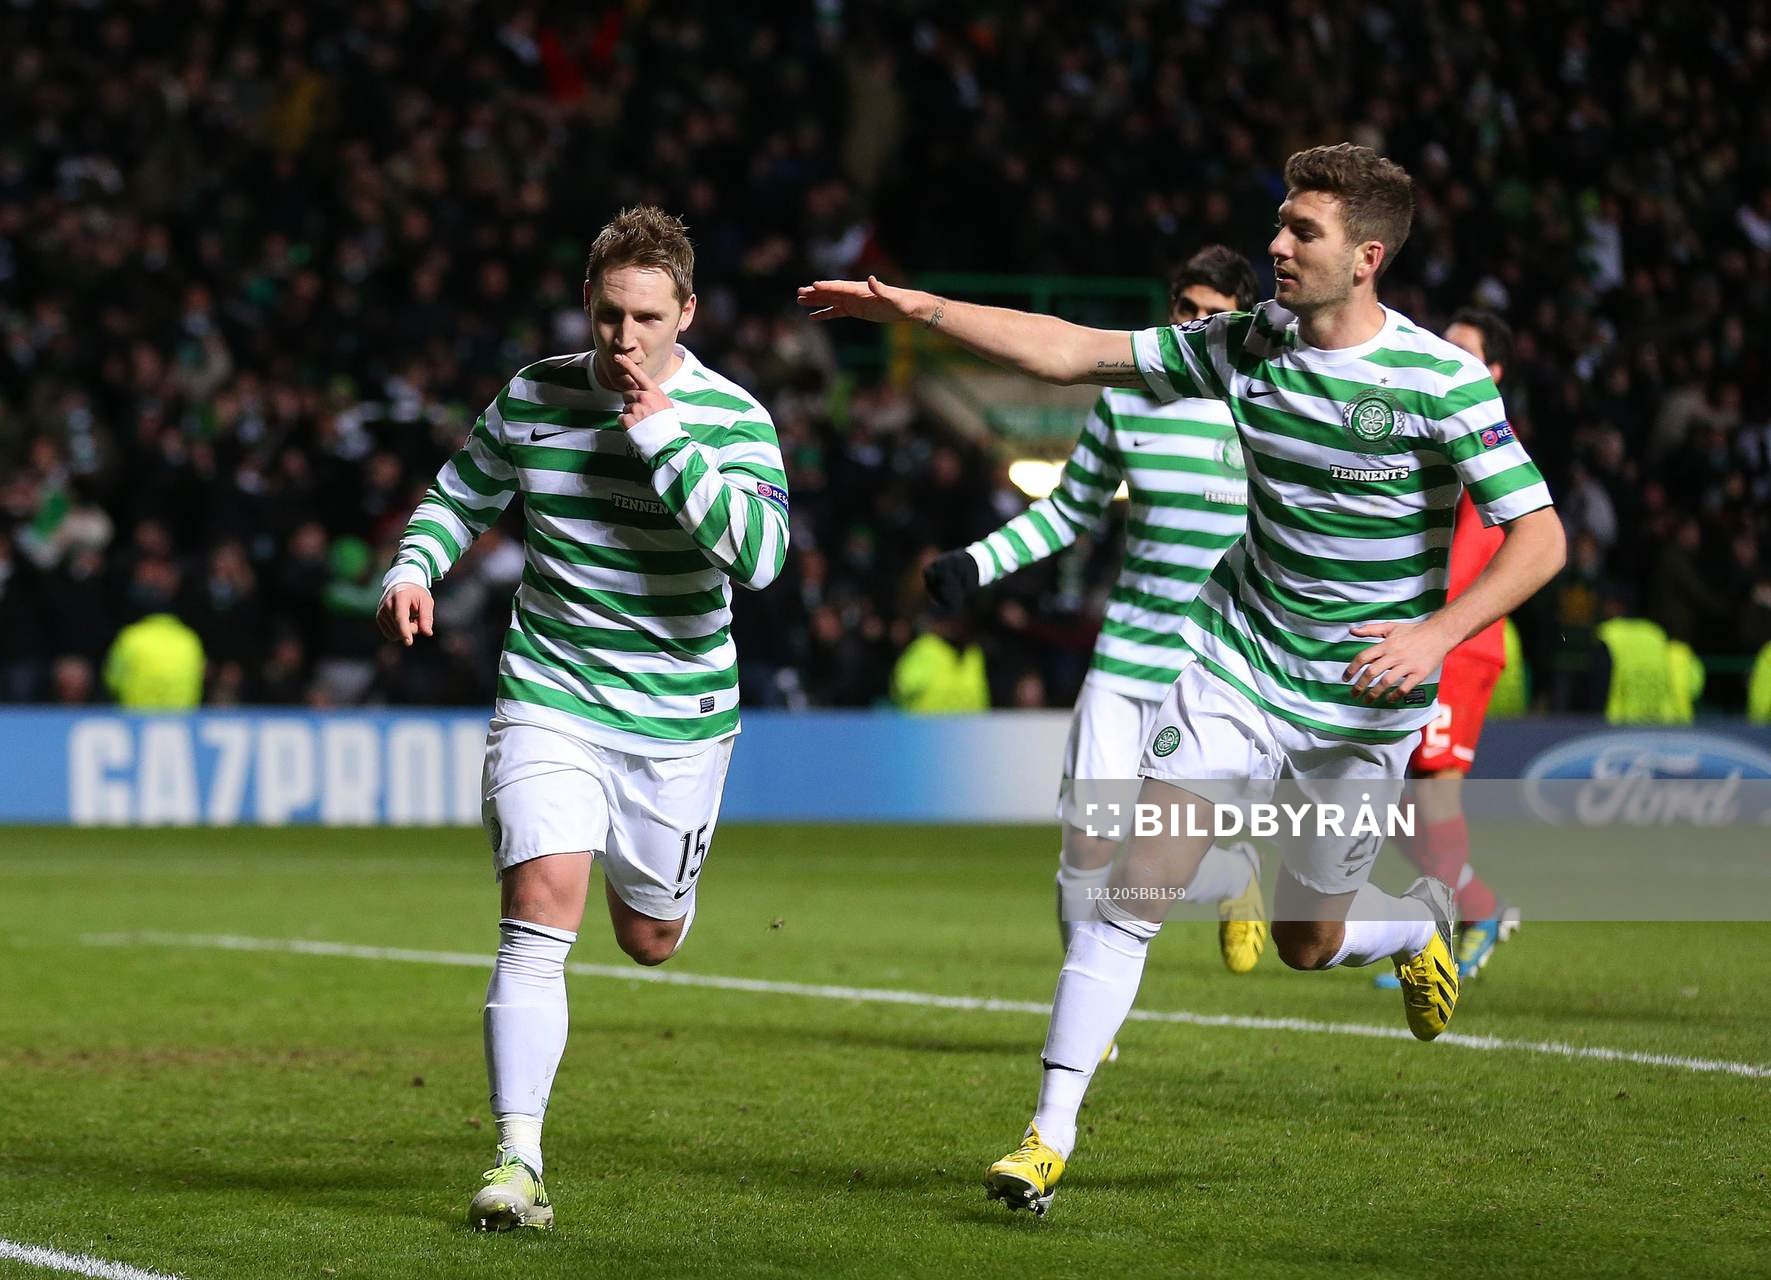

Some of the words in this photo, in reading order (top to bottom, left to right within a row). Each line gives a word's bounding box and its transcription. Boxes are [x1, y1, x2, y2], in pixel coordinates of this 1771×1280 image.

[1331, 465, 1409, 481] TENNENT'S
[1576, 748, 1744, 826] Ford
[675, 823, 708, 884] 15
